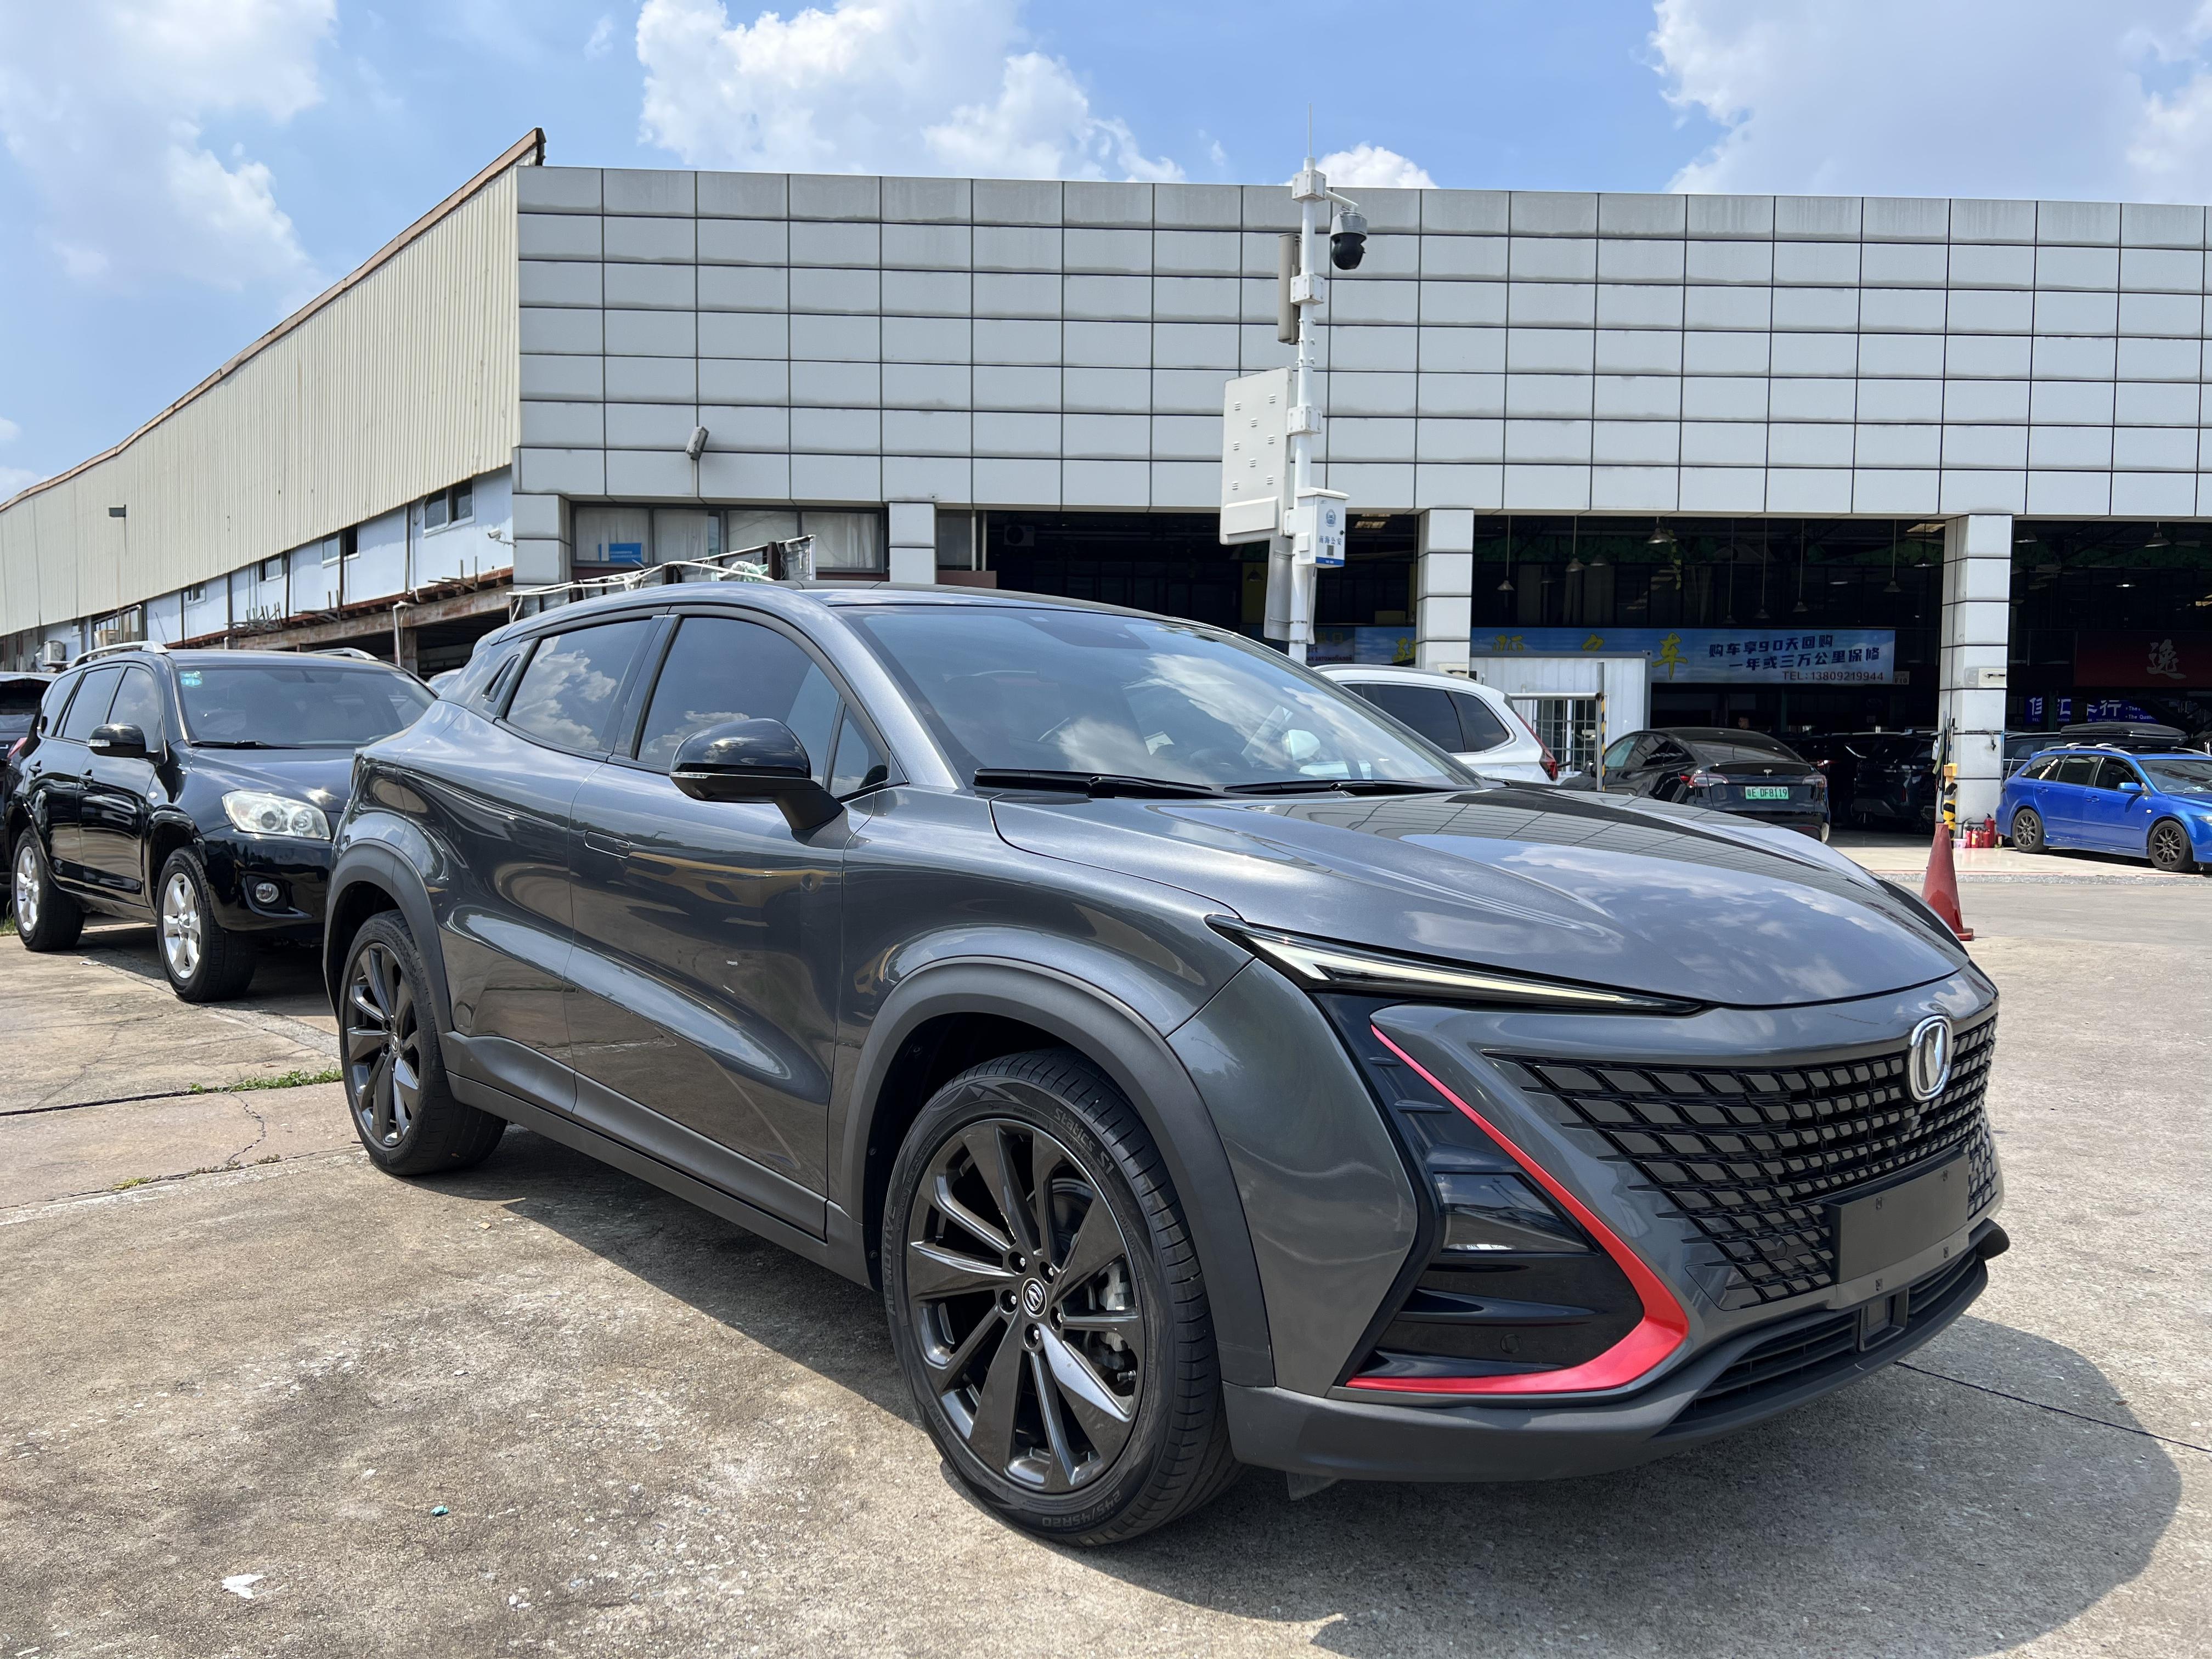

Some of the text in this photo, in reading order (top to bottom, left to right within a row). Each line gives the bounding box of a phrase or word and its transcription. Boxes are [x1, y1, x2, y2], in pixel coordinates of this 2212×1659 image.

[1709, 634, 1833, 657] 购车享90天回购
[1729, 647, 1880, 670] 一年或三万公里保修
[1760, 788, 1787, 797] DF8119
[1054, 1107, 1096, 1152] Statics
[1042, 1489, 1122, 1528] 245/45R20
